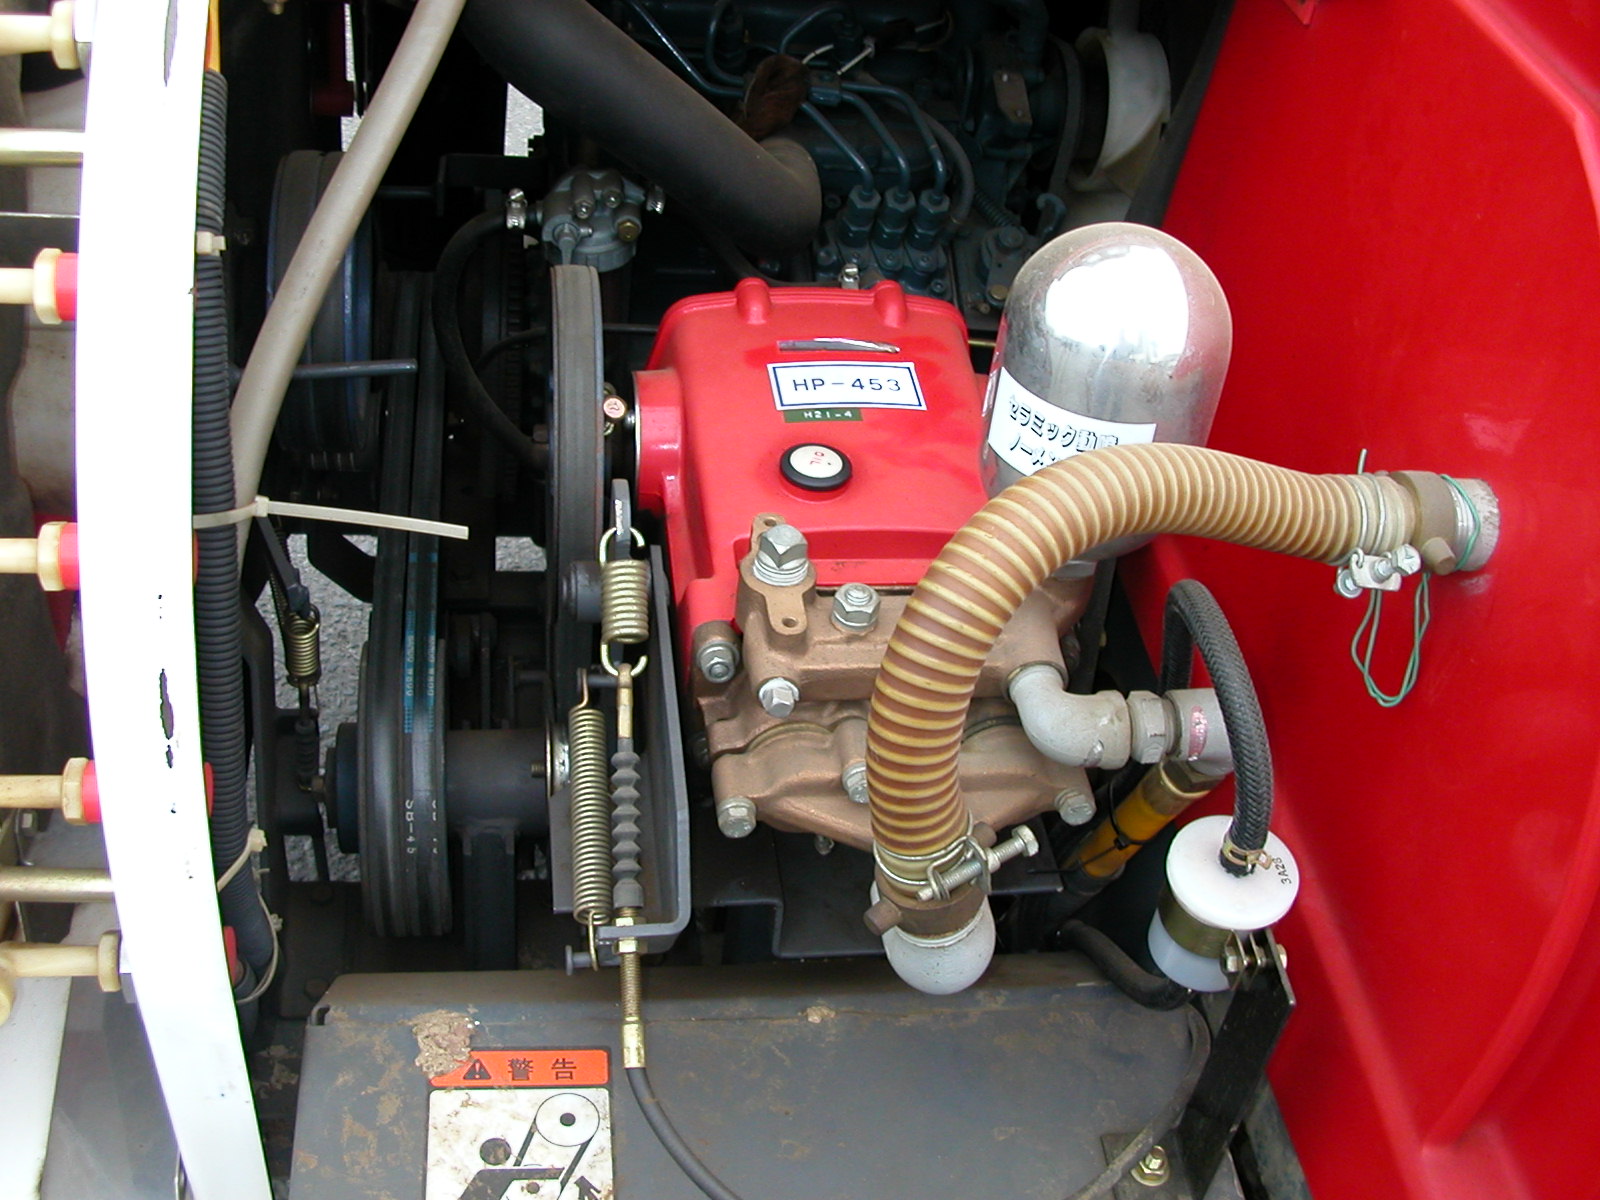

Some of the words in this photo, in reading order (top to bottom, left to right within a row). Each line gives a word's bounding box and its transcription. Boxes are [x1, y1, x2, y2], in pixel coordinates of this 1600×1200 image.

[792, 378, 901, 391] HP-453
[803, 410, 852, 419] H21-4
[508, 1057, 577, 1081] 警告
